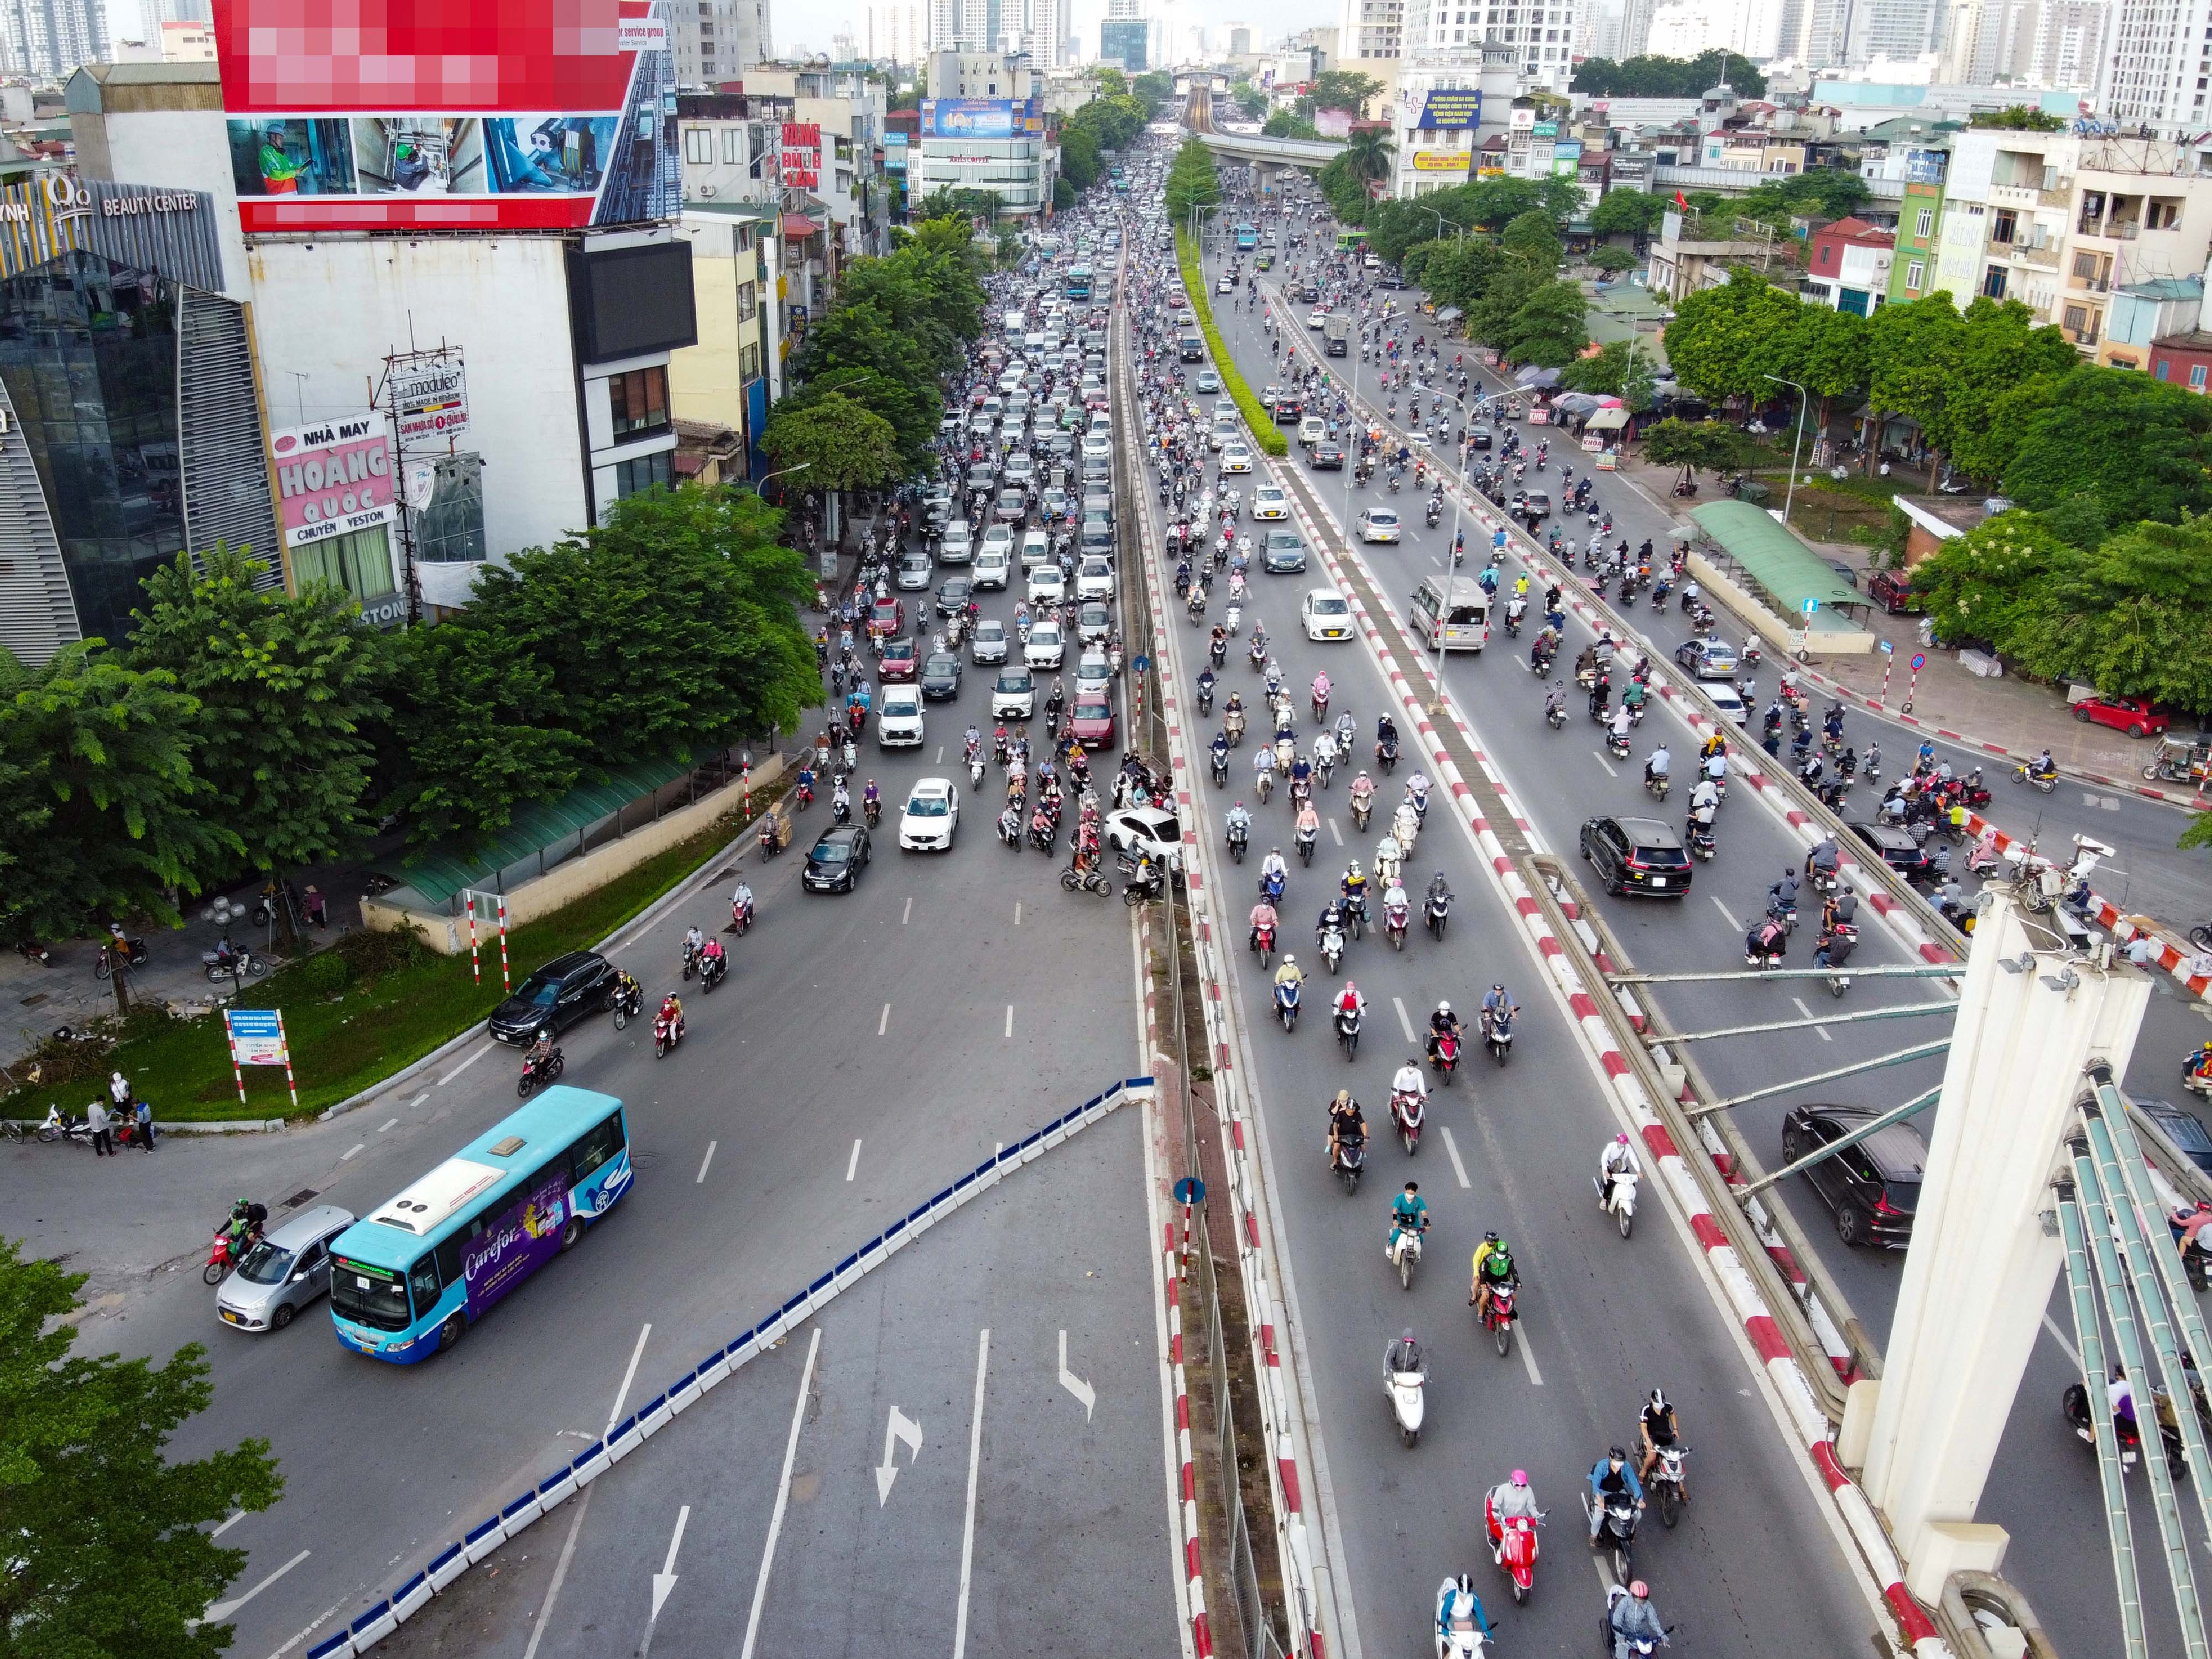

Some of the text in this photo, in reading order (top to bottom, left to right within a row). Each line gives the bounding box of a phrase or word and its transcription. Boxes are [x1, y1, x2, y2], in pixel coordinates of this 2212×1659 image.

[625, 26, 645, 37] service
[647, 28, 664, 38] group
[104, 194, 197, 216] BEAUTY CENTER
[410, 372, 457, 397] moduleo
[416, 397, 430, 405] MADE
[304, 424, 335, 446] NHÀ
[339, 421, 371, 441] MAY
[279, 446, 388, 498] HOÀNG
[303, 487, 375, 523] QUỐC
[297, 509, 384, 541] CHUYÊN VESTON
[465, 1227, 516, 1281] Carefor
